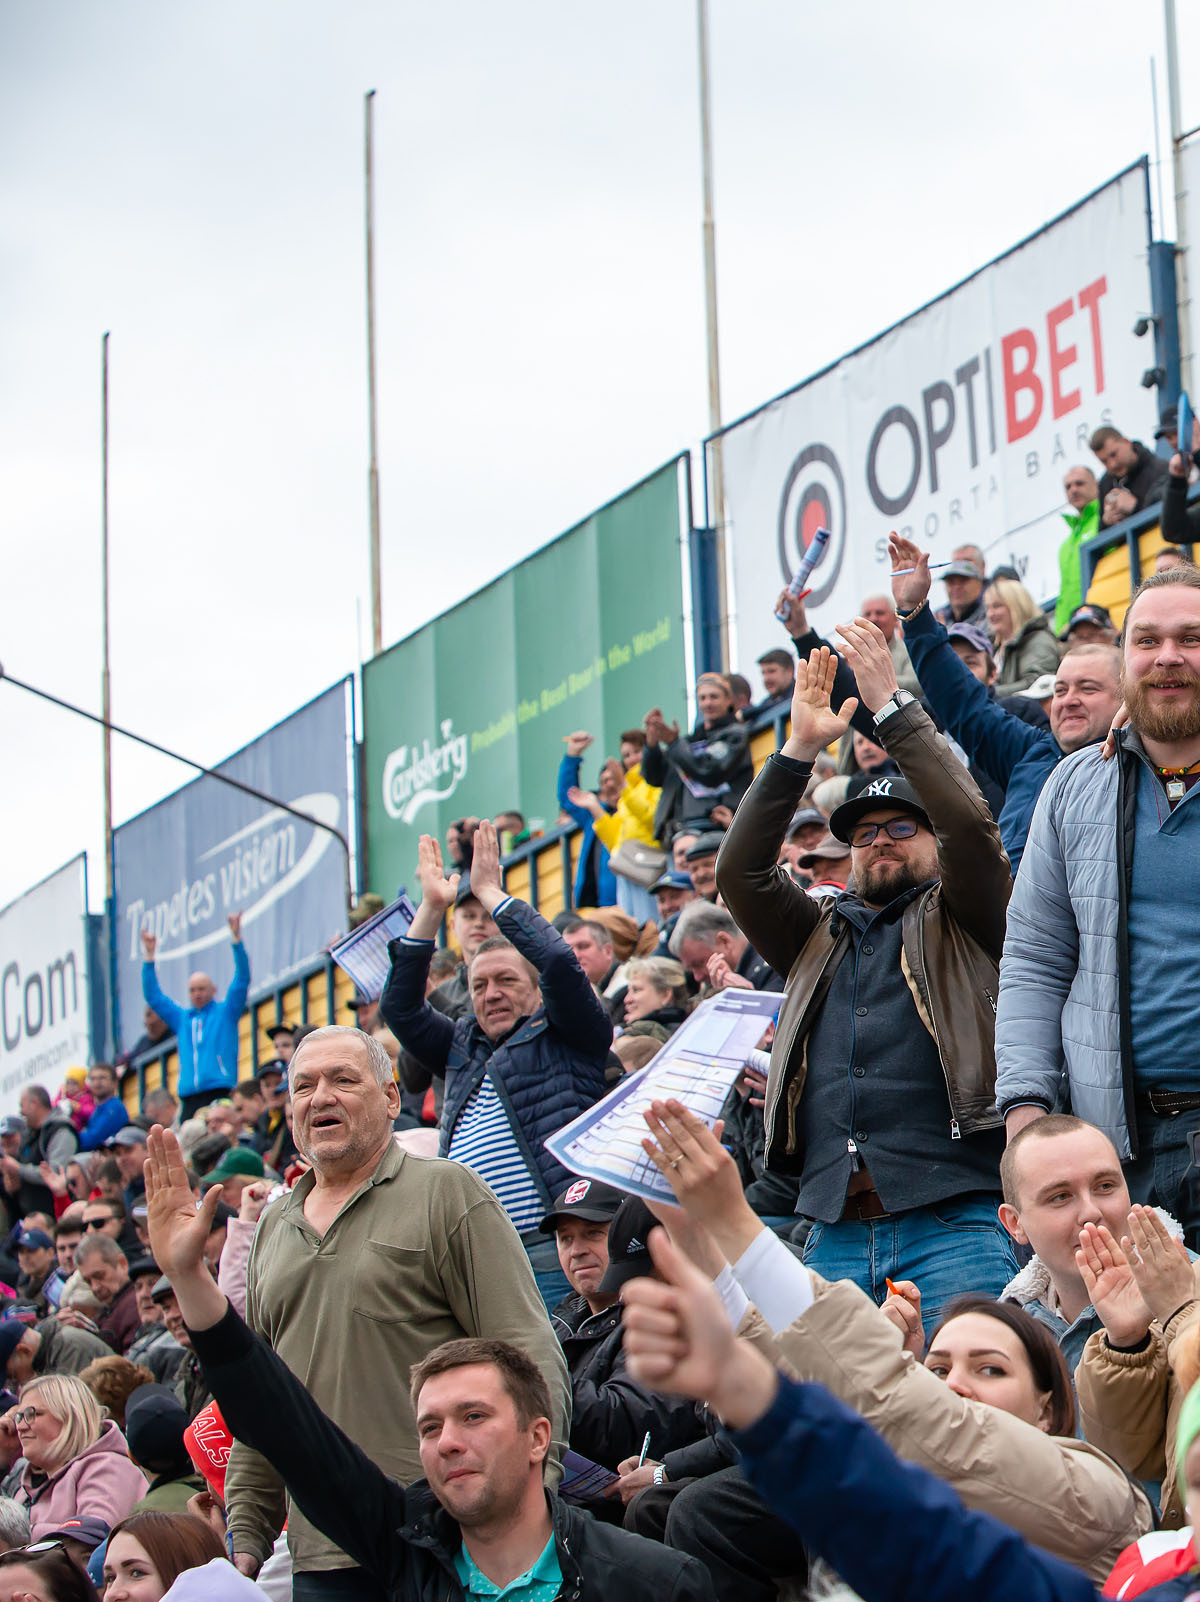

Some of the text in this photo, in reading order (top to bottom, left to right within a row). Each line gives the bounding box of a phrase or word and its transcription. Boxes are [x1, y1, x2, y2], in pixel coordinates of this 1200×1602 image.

[865, 275, 1108, 517] OPTIBET
[517, 699, 540, 725] the
[608, 643, 632, 671] the
[633, 617, 670, 656] World
[382, 724, 469, 824] Carlsberg
[868, 778, 893, 796] NY
[126, 823, 296, 962] Tapetes visiem
